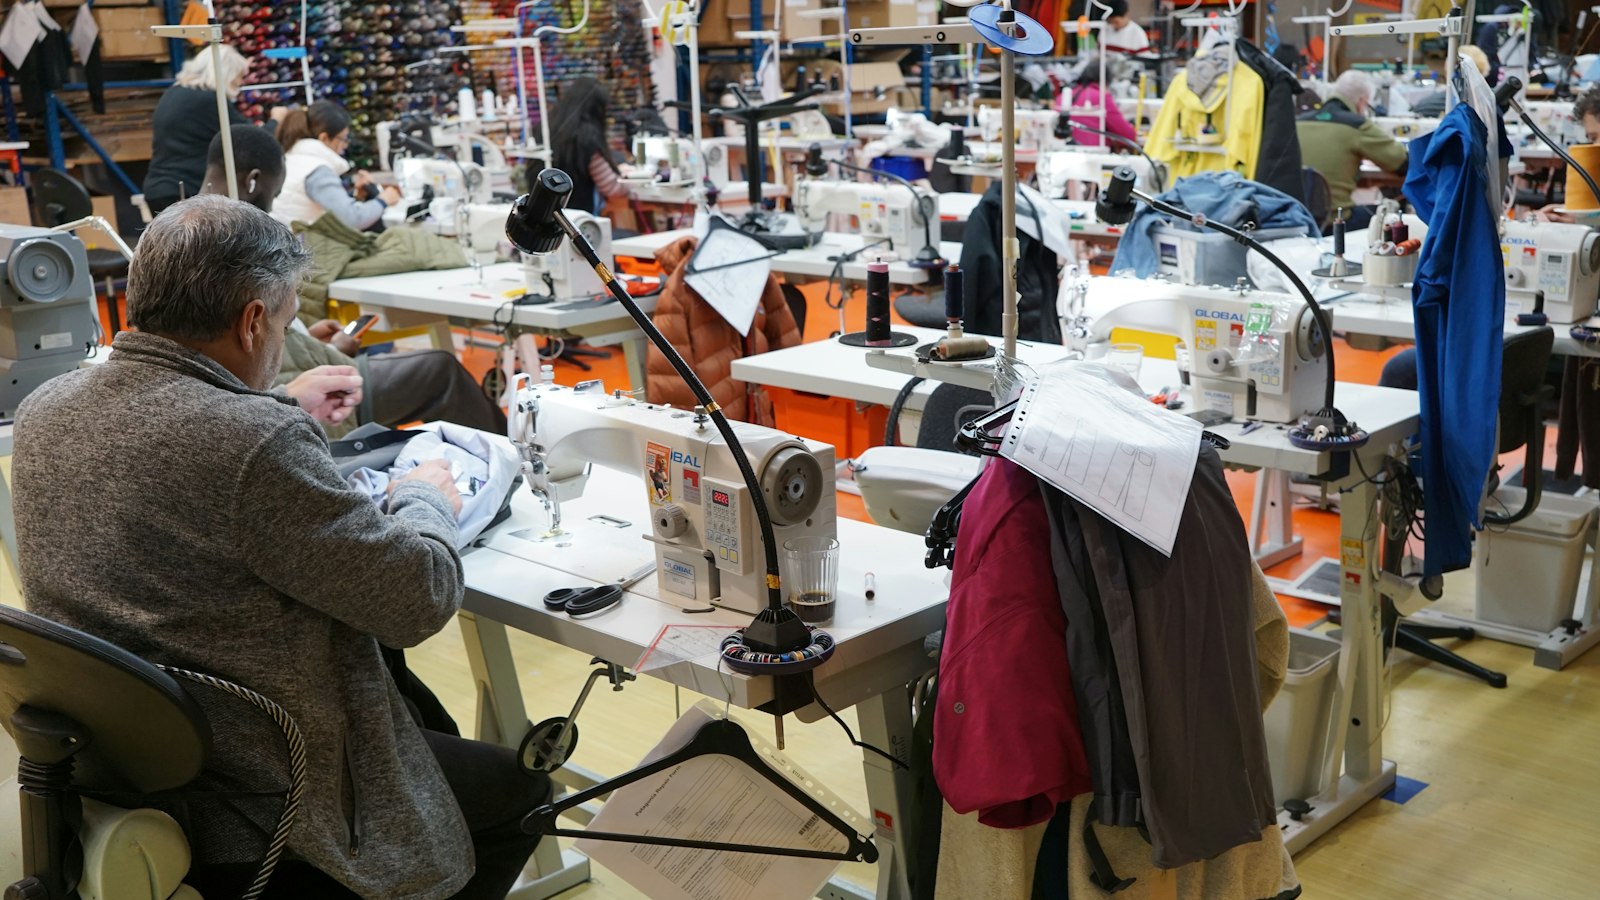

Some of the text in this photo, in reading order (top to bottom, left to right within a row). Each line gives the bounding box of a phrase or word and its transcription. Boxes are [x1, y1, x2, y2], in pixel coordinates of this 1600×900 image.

[1499, 237, 1536, 246] LOBAL
[1195, 308, 1246, 322] GLOBAL
[670, 450, 701, 468] BAL
[664, 561, 693, 576] GLOBAL
[634, 793, 656, 817] Patagonia
[655, 778, 670, 794] Repair
[668, 765, 682, 779] Form
